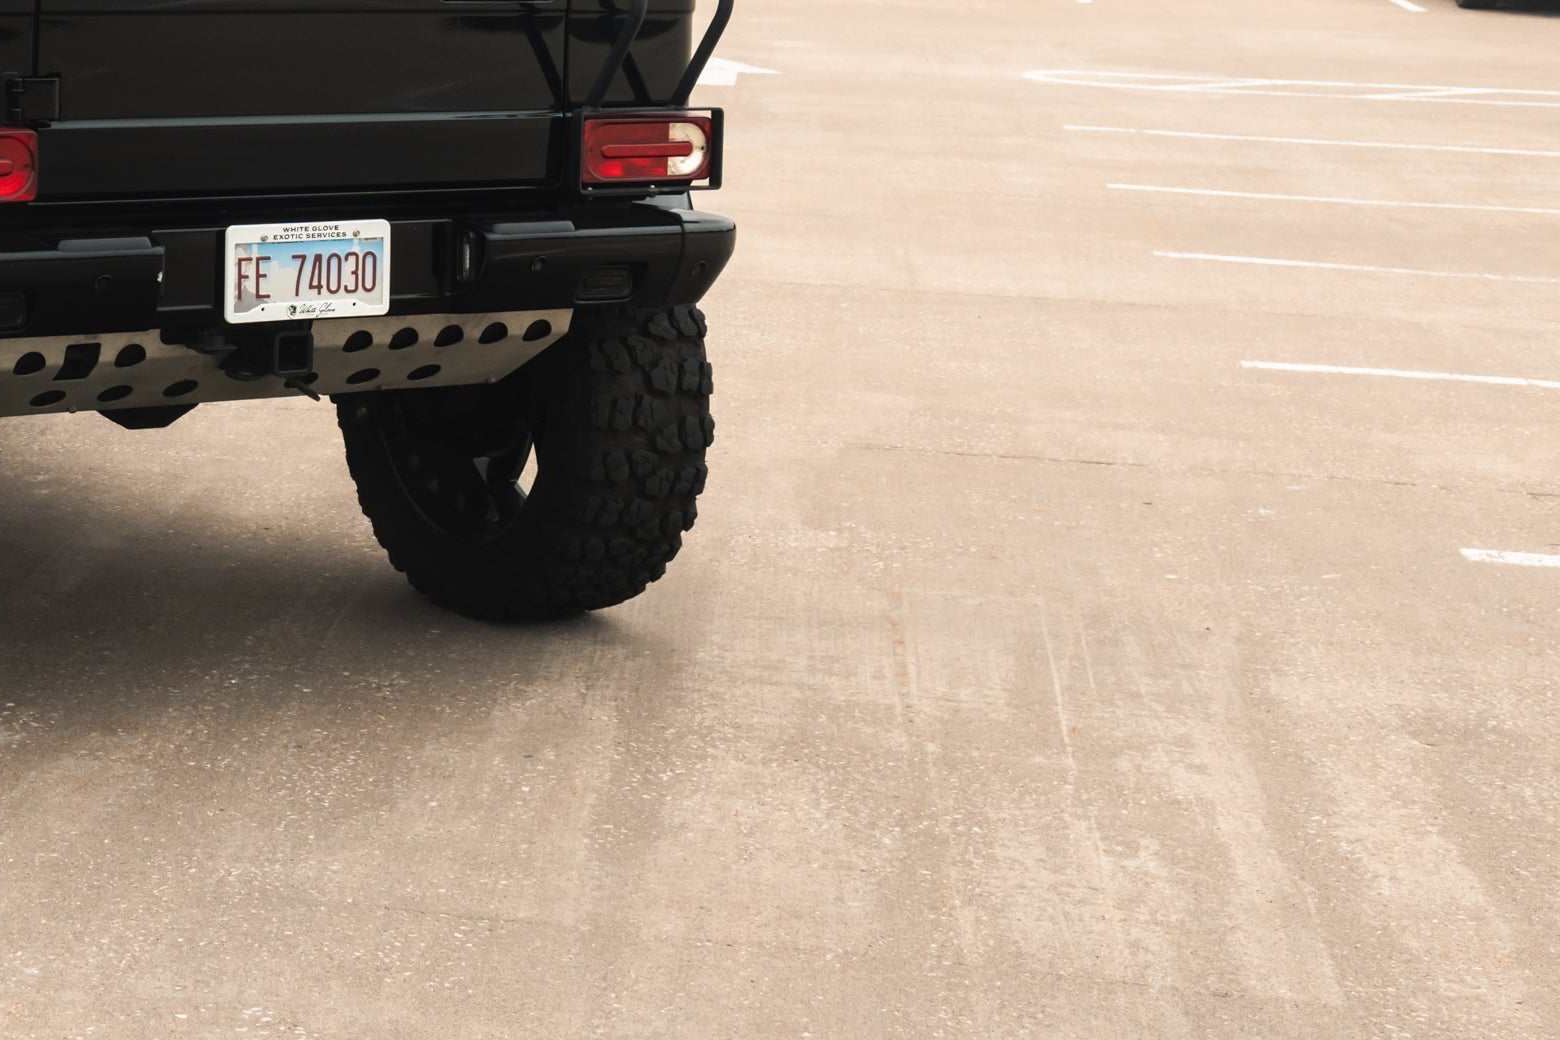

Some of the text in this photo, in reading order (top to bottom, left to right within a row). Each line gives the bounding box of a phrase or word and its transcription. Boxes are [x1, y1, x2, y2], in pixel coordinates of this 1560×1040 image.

[312, 224, 340, 232] GLOVE
[306, 231, 347, 239] SERVICES
[291, 250, 378, 297] 74030
